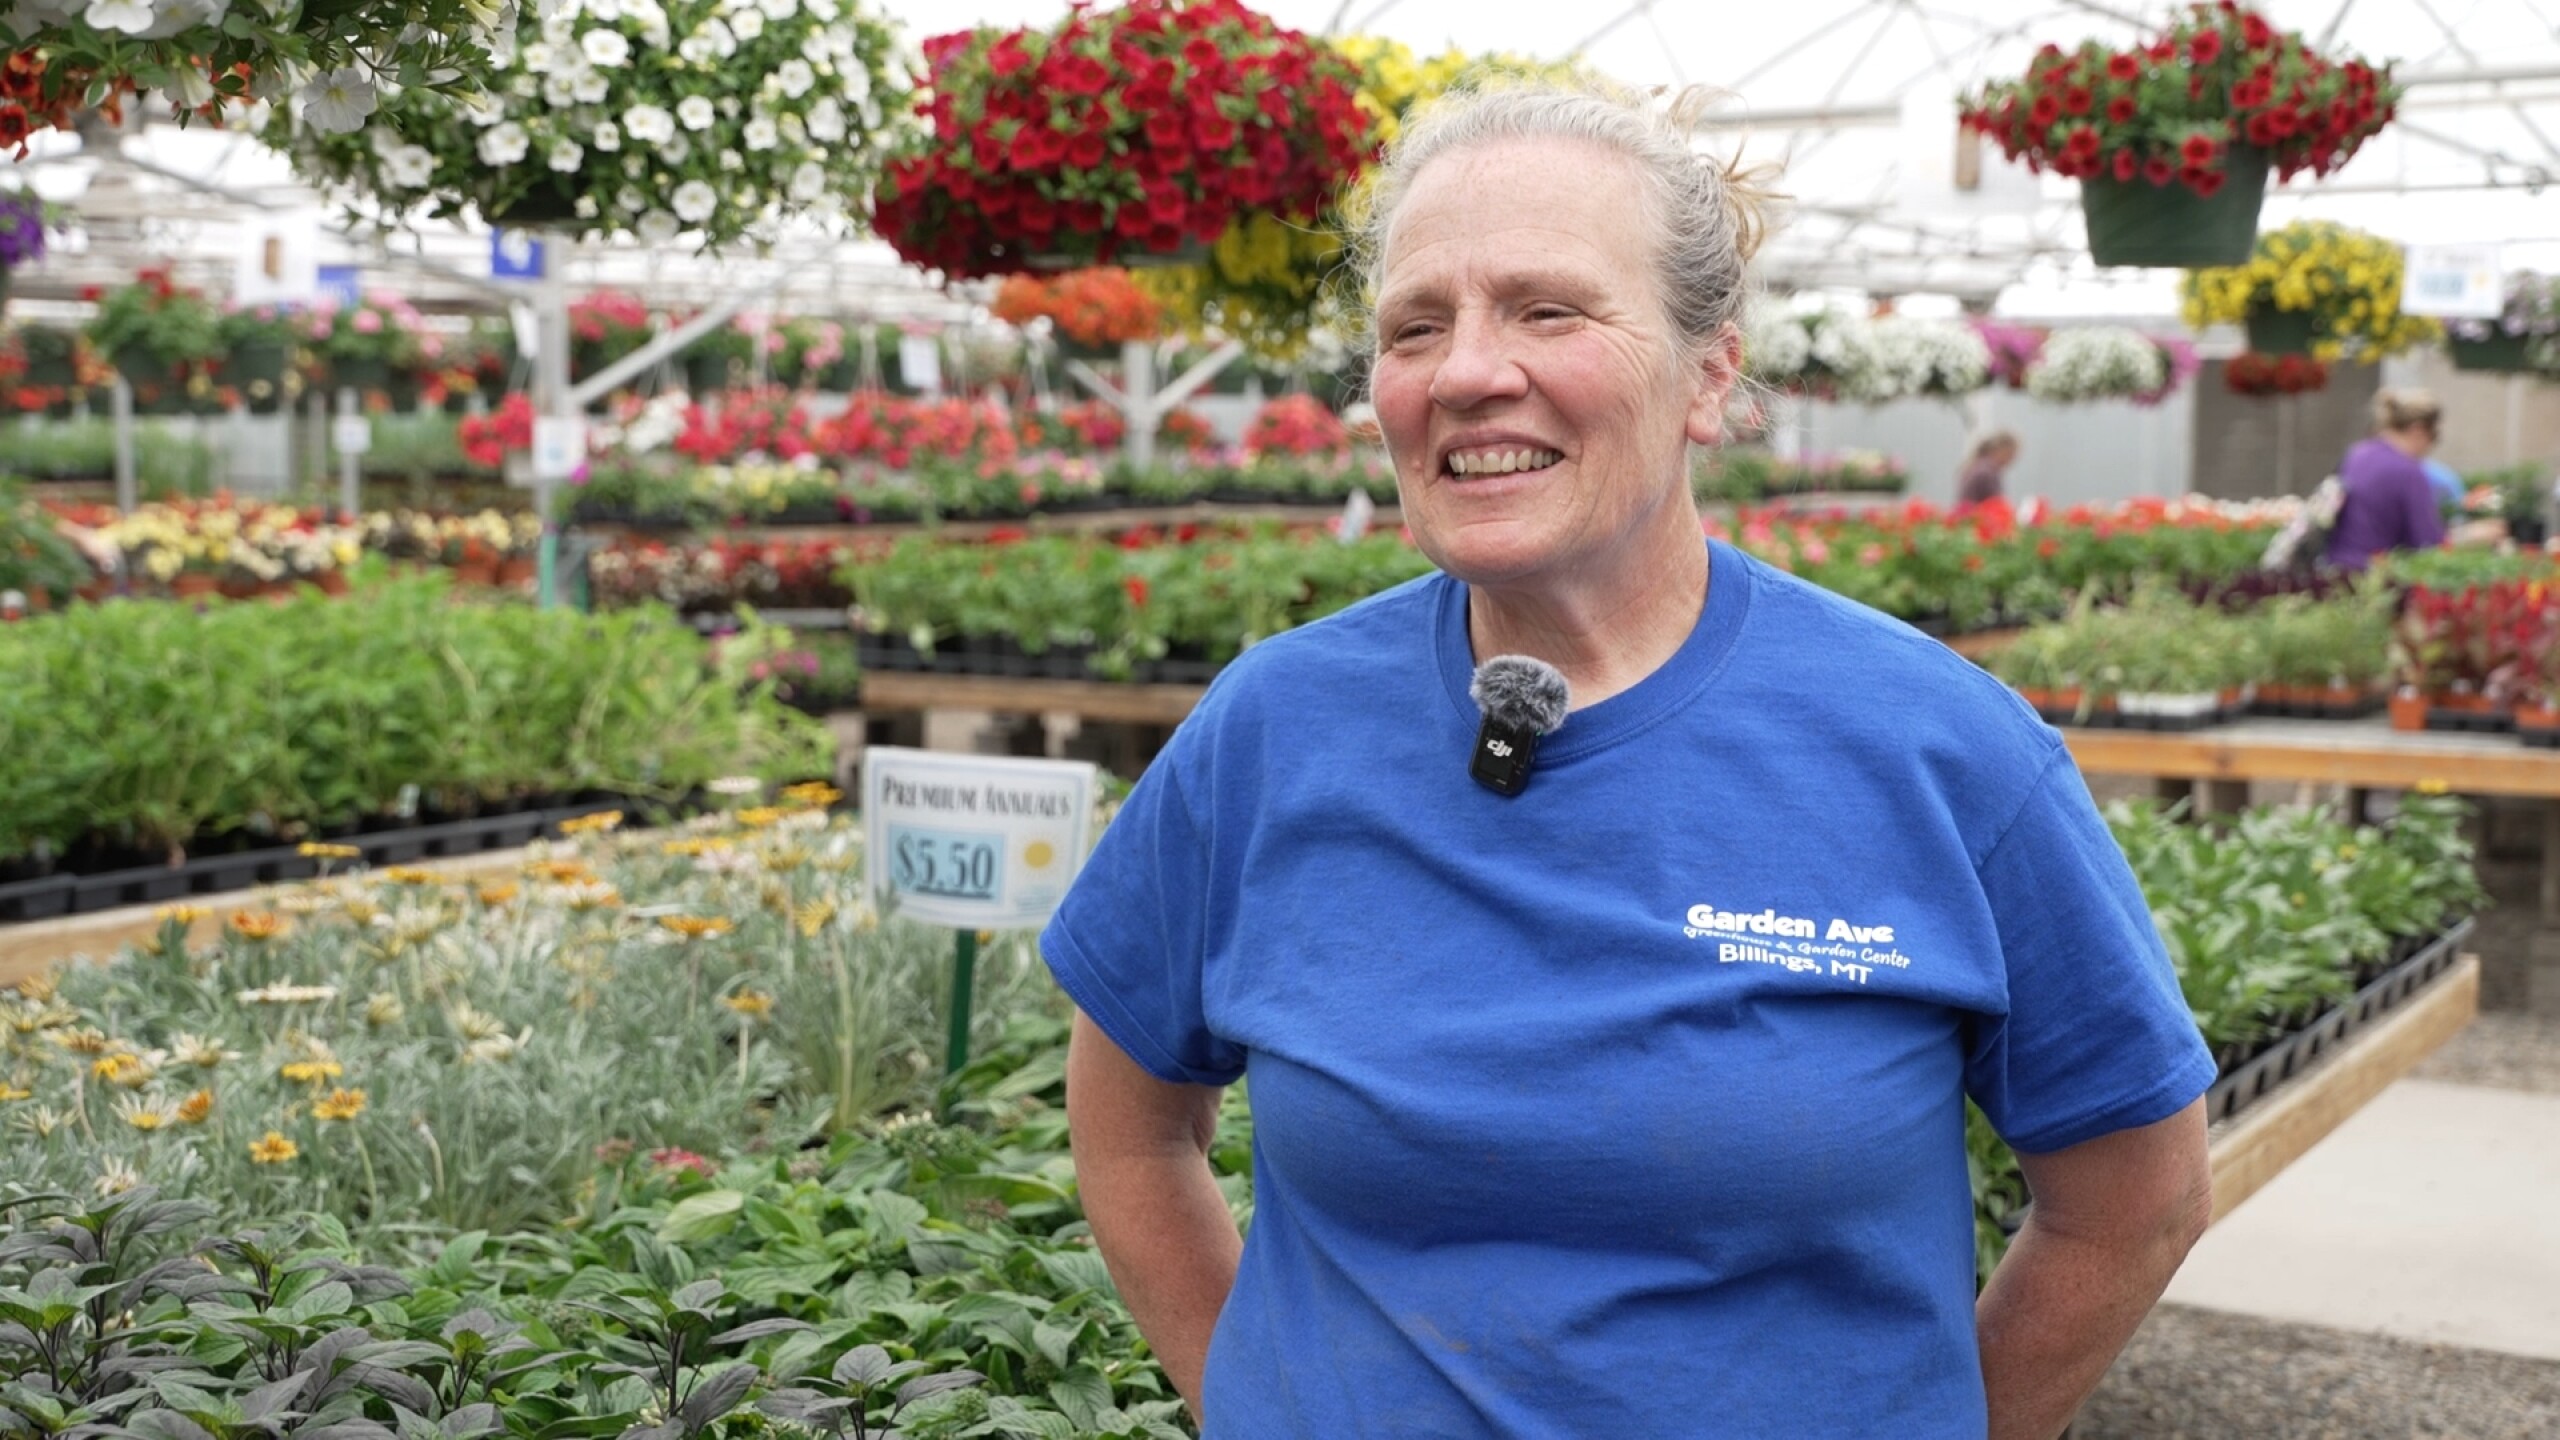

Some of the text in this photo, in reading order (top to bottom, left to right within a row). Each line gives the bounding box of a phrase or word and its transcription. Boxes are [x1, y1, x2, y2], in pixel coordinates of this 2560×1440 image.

[896, 832, 994, 890] $5.50
[1687, 903, 1896, 944] Garden Ave
[1719, 943, 1874, 985] Billings, MT
[1797, 942, 1857, 959] Garden
[1861, 947, 1911, 969] Center
